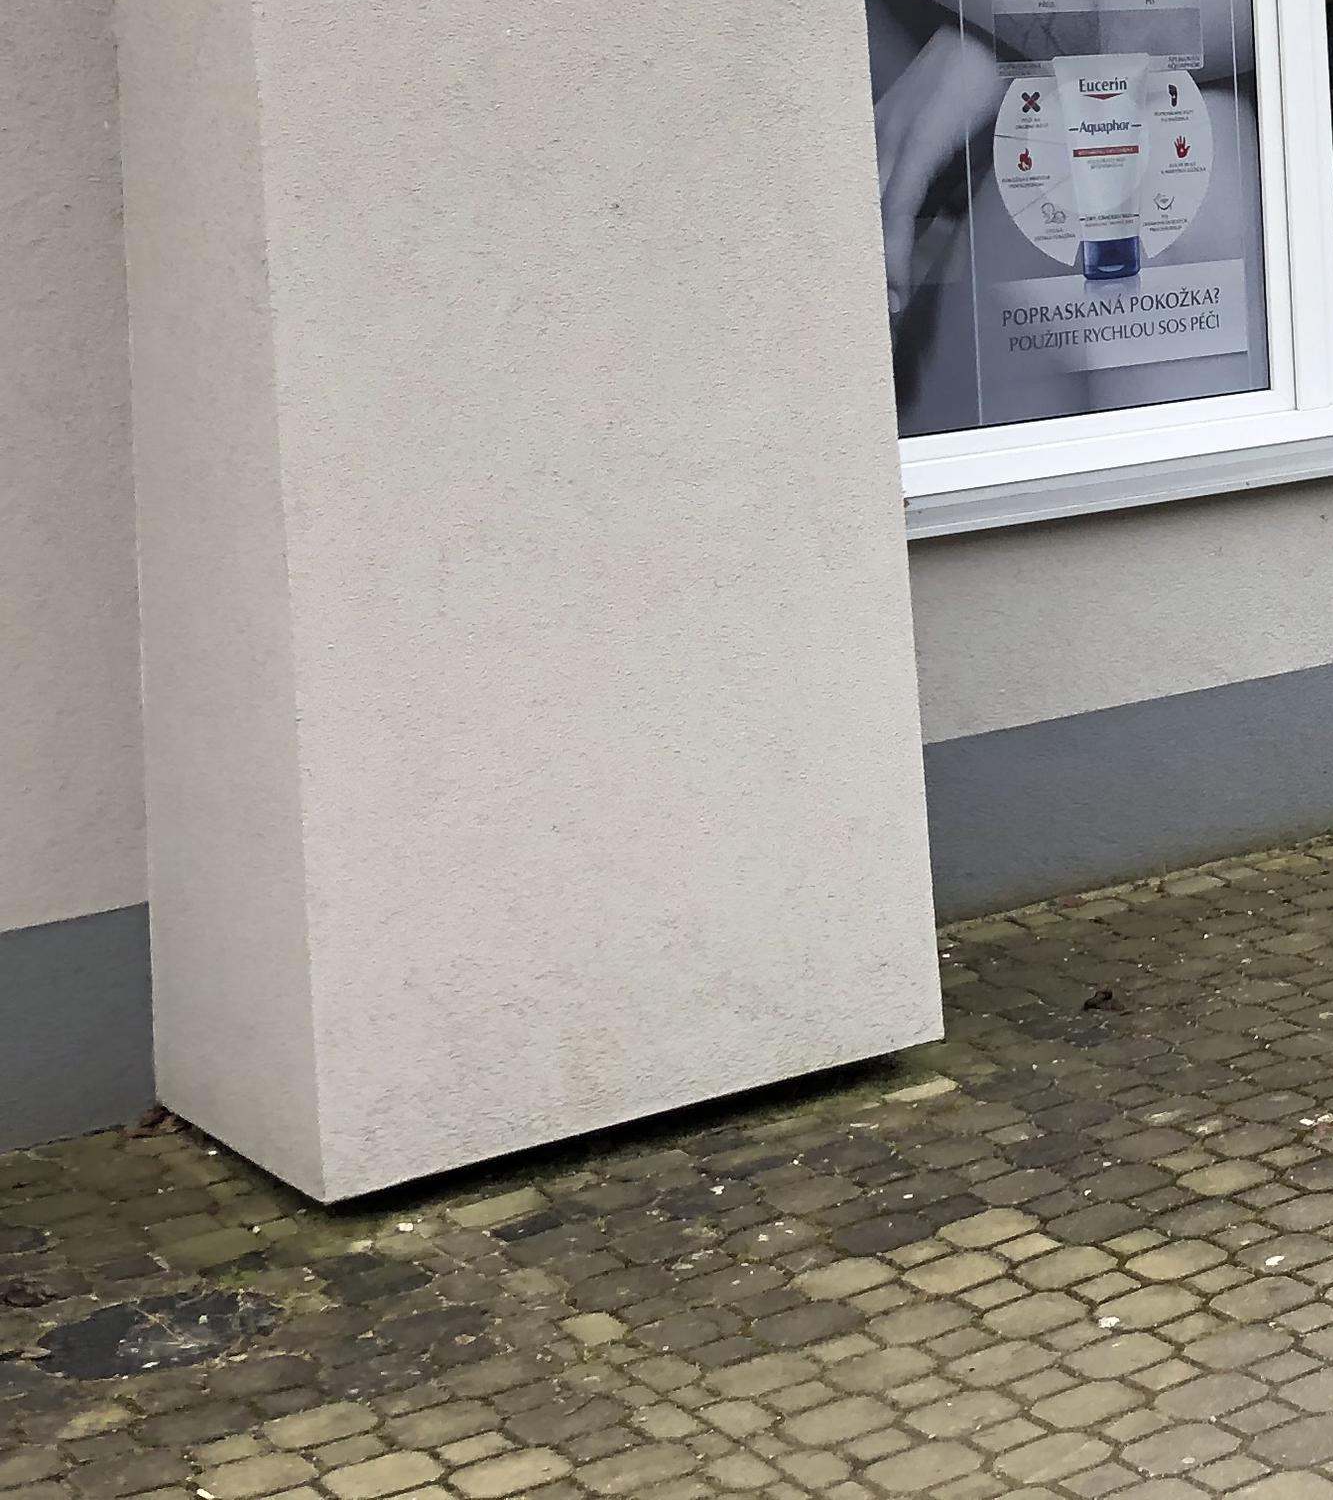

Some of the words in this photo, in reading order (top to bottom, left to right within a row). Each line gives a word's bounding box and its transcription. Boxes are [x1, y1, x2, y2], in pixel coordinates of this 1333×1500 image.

[1078, 77, 1128, 92] Eucerin
[1079, 119, 1130, 136] Aquaphor
[1002, 294, 1126, 327] POPRASKANÁ
[1130, 287, 1221, 313] POKOŽKA?
[1009, 330, 1080, 352] POUŽIJTE
[1083, 322, 1155, 344] RYCHLOU
[1158, 318, 1187, 335] SOS
[1190, 310, 1221, 331] PÉČI
